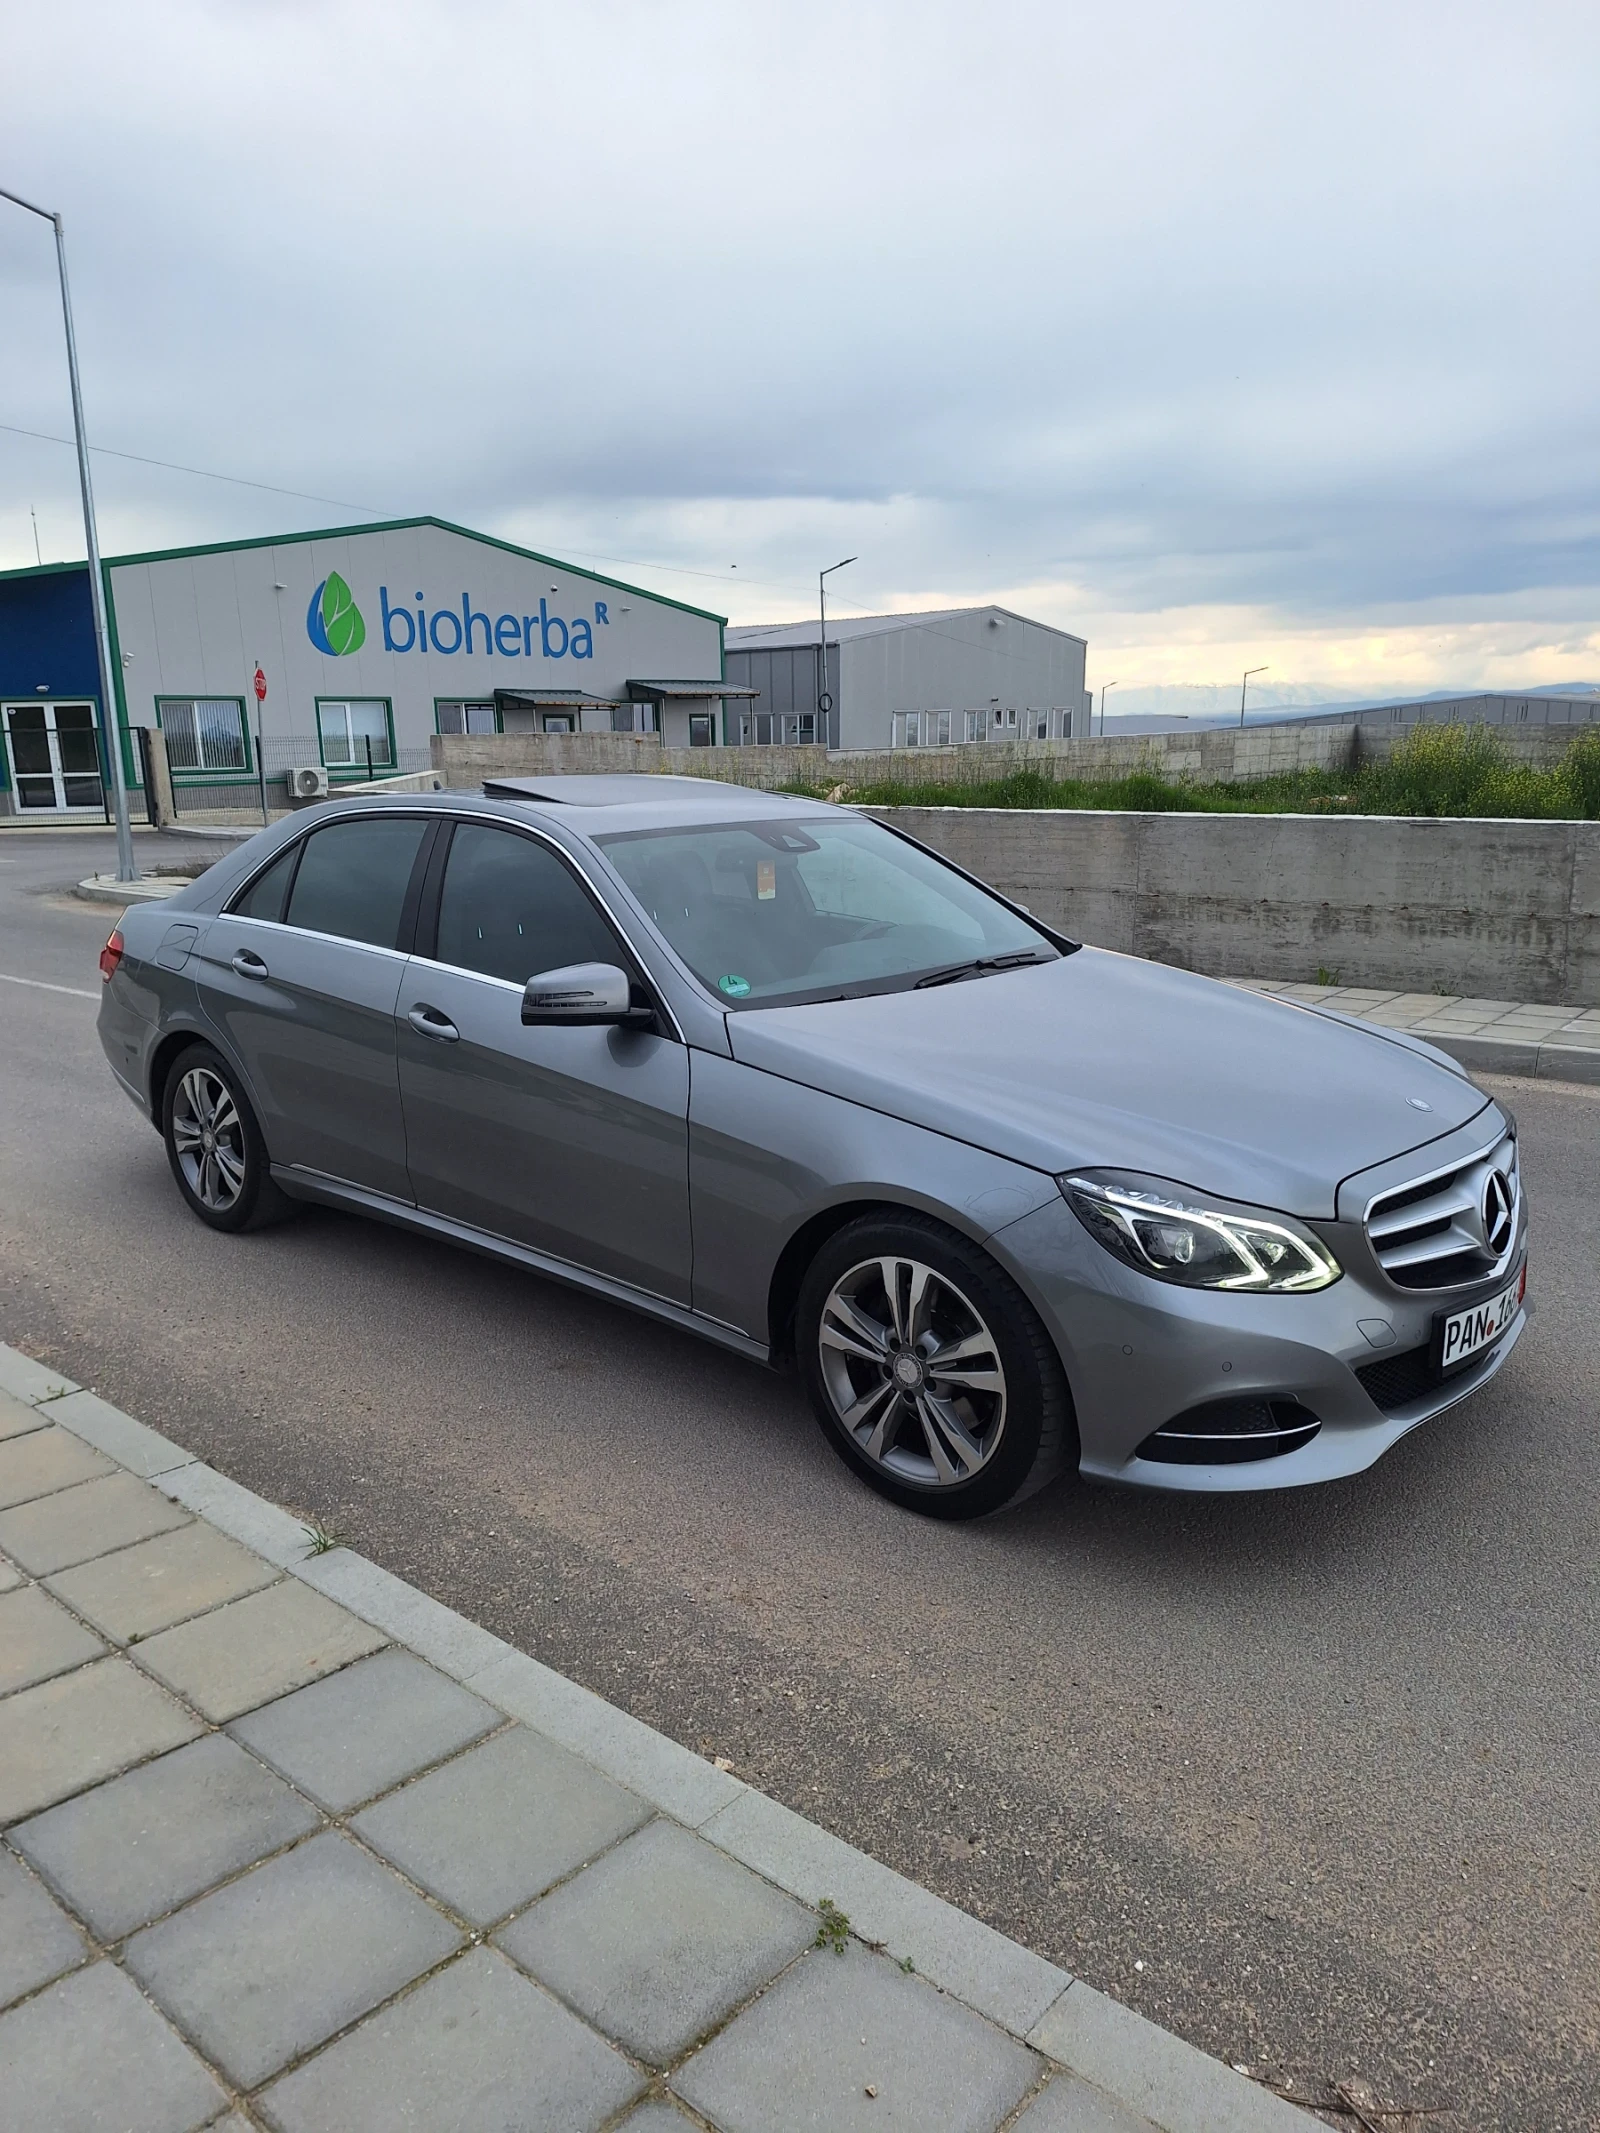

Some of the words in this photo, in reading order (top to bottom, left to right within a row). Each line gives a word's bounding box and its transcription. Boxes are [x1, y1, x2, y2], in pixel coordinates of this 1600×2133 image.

[380, 586, 593, 659] bioherba
[595, 601, 610, 625] R
[727, 975, 738, 986] 4
[1446, 1306, 1490, 1360] PAN
